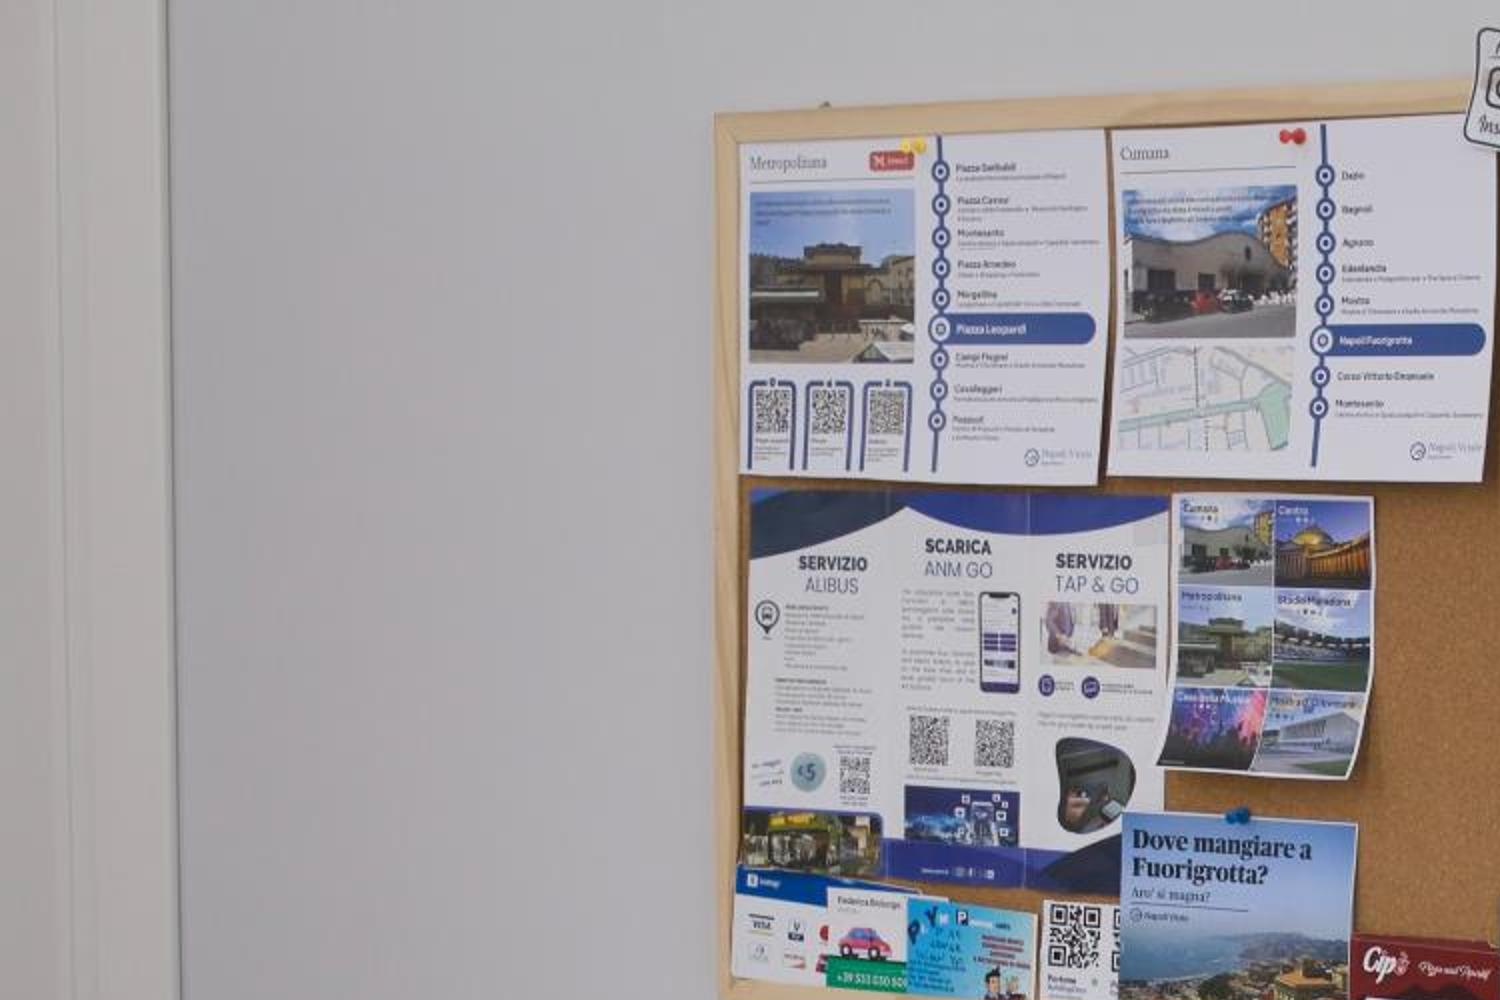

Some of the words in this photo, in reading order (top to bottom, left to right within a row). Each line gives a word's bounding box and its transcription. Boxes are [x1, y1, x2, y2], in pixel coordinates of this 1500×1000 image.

[1120, 146, 1170, 161] Cumana
[751, 155, 828, 174] Metropolitana
[956, 163, 980, 173] Piazza
[957, 196, 981, 205] Piazza
[957, 260, 981, 269] Piazza
[956, 324, 985, 335] Piazza
[985, 323, 1027, 336] Leopardi
[1339, 335, 1368, 347] Napoli
[925, 538, 992, 555] SCARICA
[799, 555, 868, 572] SERVIZIO
[925, 561, 961, 578] ANM
[966, 561, 993, 579] GO
[1055, 553, 1132, 571] SERVIZIO
[805, 577, 859, 594] ALIBUS
[1056, 575, 1087, 593] TAP
[1091, 577, 1105, 594] &
[1110, 576, 1139, 595] GO
[1132, 828, 1188, 851] Dove
[1193, 832, 1297, 861] mangiare
[1299, 847, 1312, 860] a
[1132, 857, 1268, 887] Fuorigrotta?
